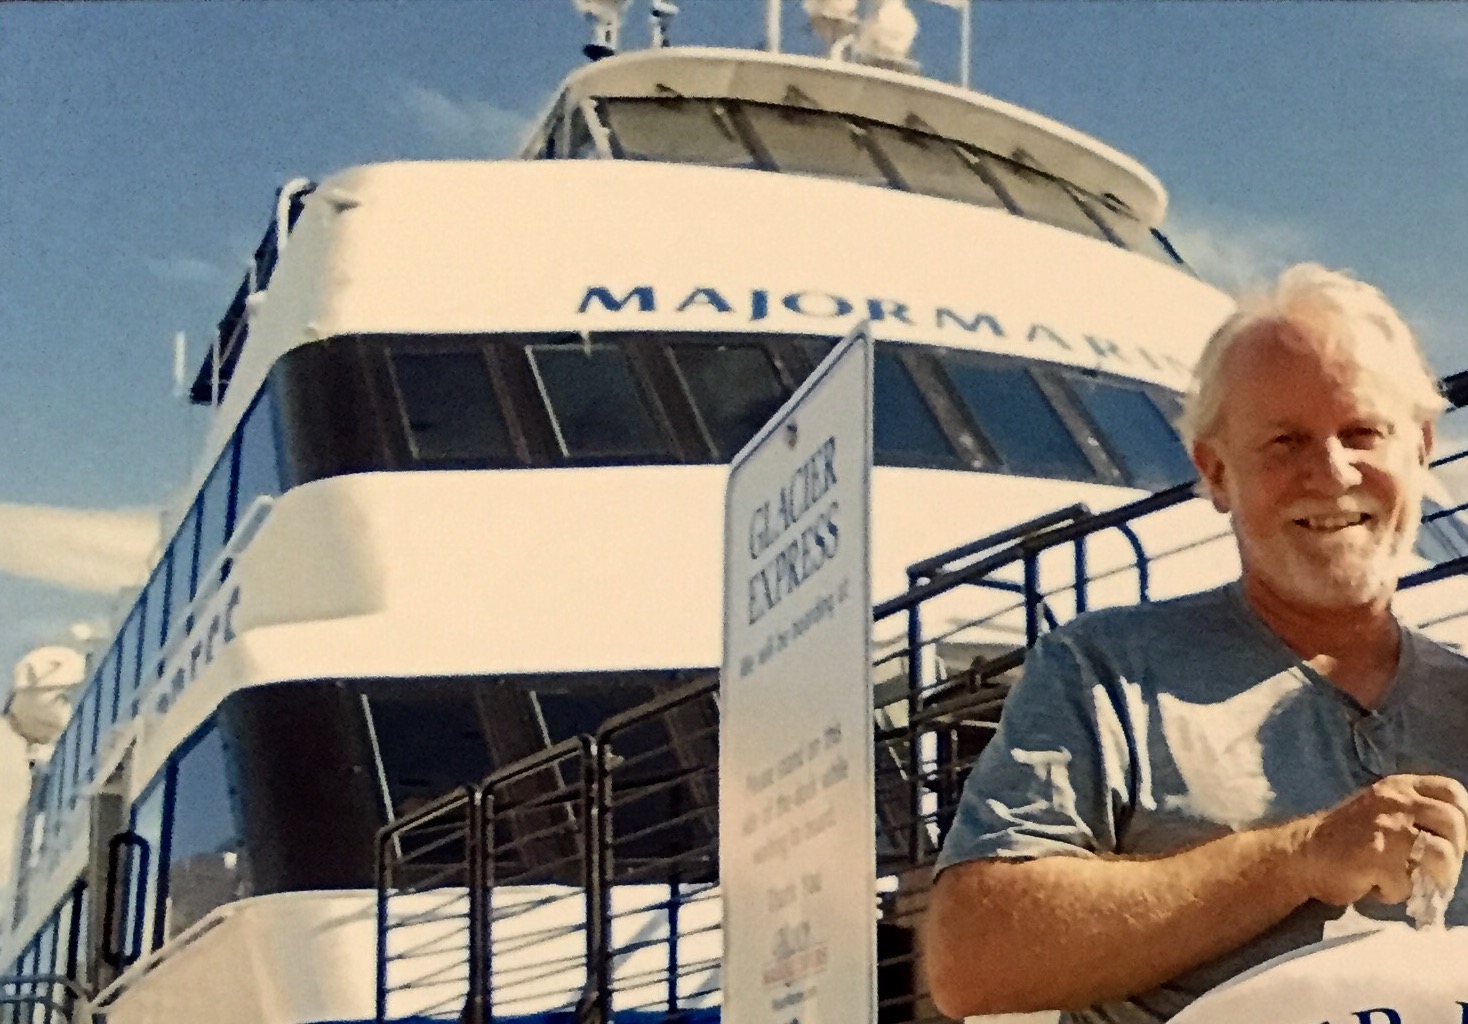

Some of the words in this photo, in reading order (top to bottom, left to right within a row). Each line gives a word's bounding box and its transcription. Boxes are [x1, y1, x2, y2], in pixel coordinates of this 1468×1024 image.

[577, 284, 915, 326] MAJOR
[750, 435, 837, 559] GLACIER
[749, 501, 838, 624] EXPRESS
